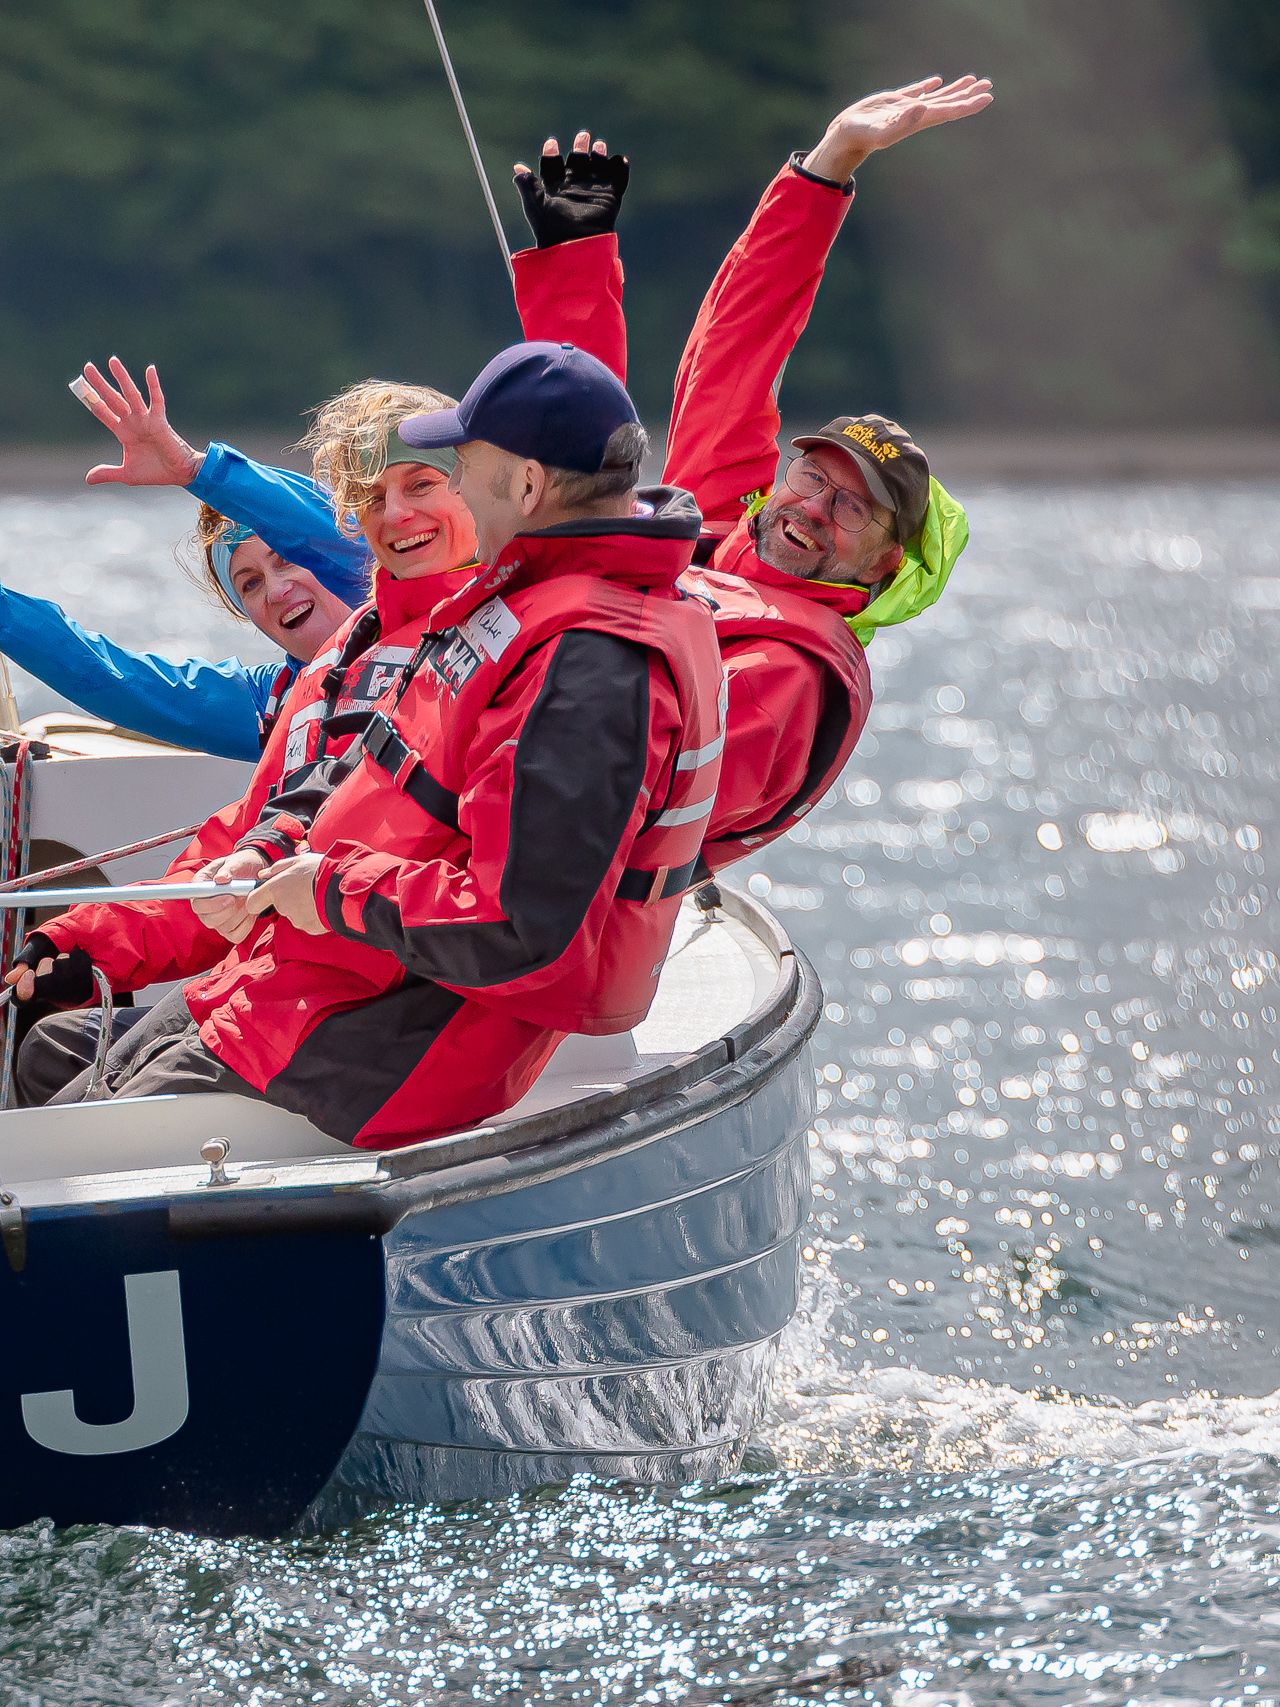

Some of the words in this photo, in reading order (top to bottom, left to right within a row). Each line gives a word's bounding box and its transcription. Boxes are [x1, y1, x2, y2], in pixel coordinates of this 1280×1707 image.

[842, 426, 886, 463] Wolfskin
[850, 423, 877, 439] Jack
[21, 1270, 189, 1455] J
